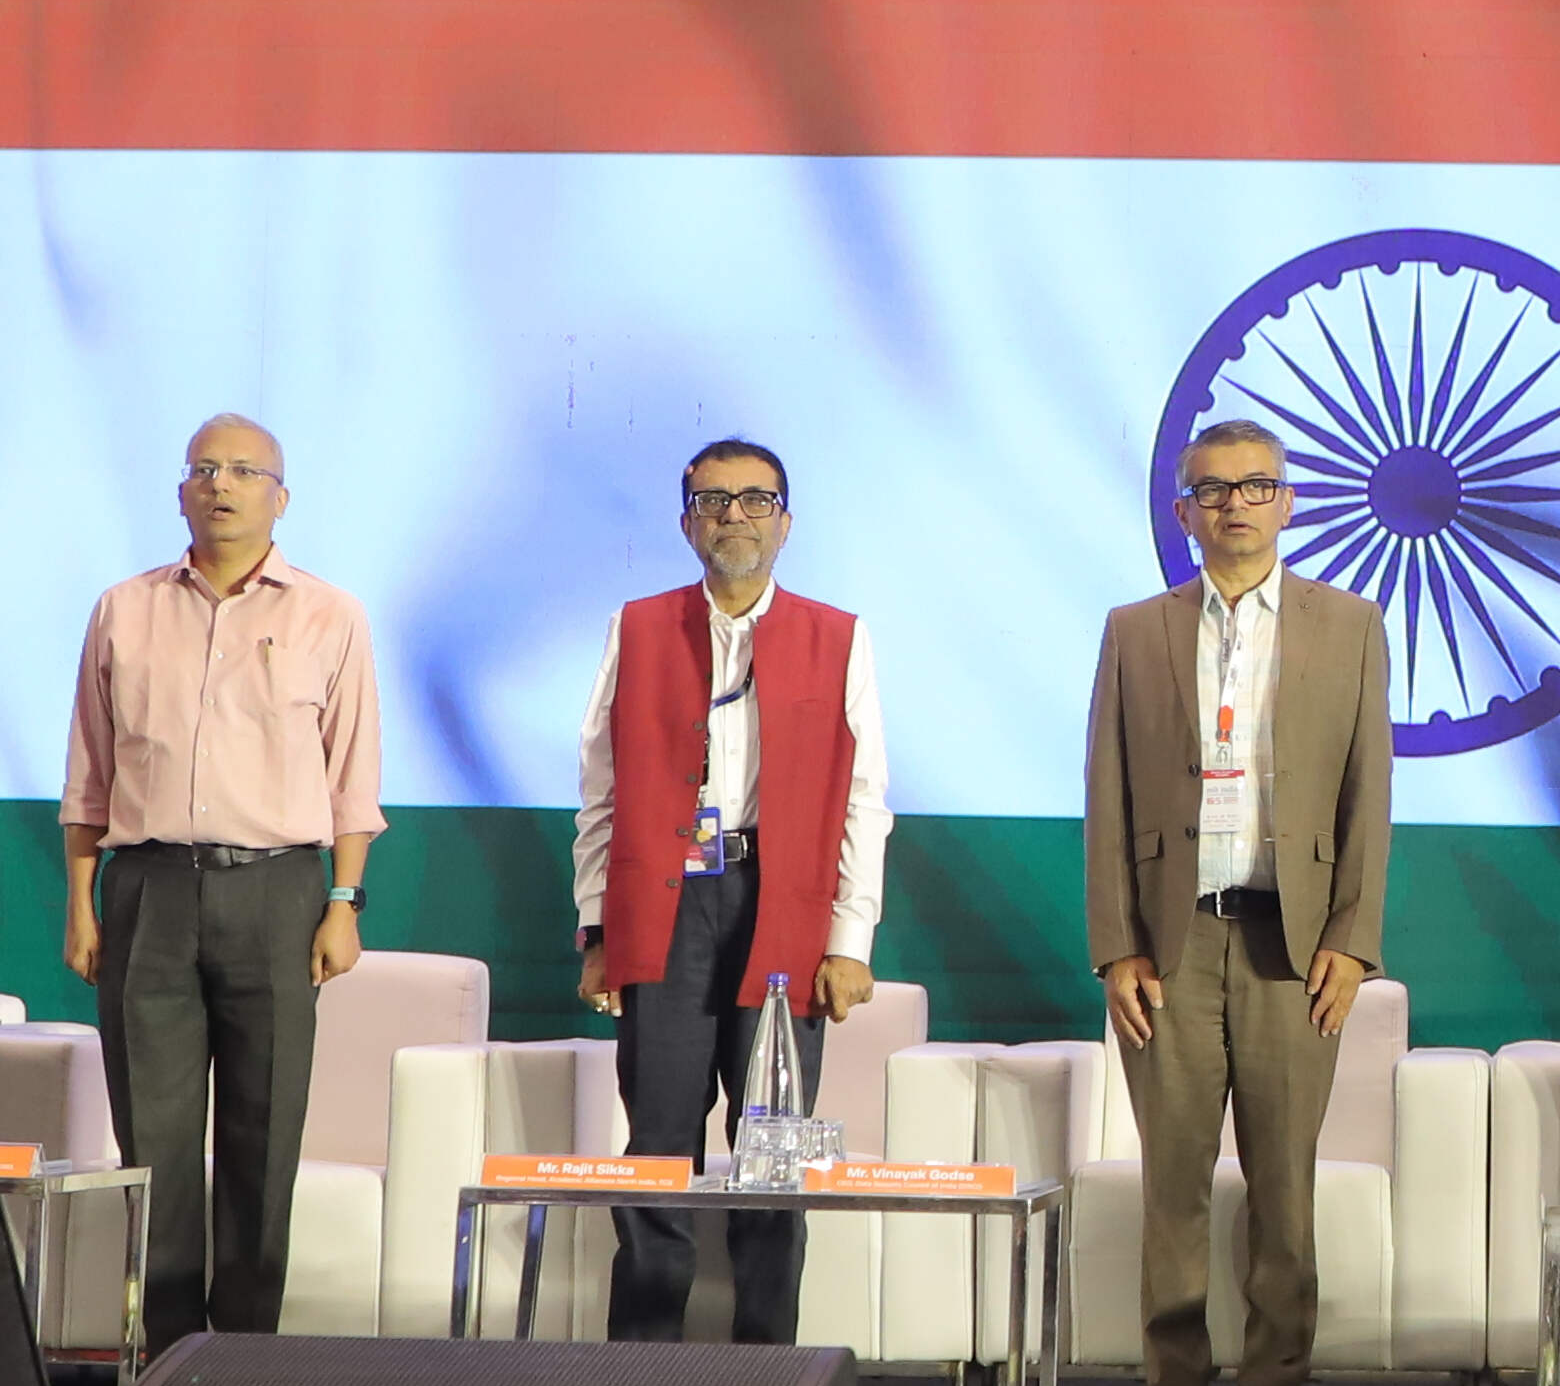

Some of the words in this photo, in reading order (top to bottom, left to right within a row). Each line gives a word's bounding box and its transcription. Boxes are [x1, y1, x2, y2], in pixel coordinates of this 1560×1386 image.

[537, 1162, 559, 1175] Mr.
[846, 1167, 868, 1179] Mr.
[872, 1167, 927, 1183] Vinayak
